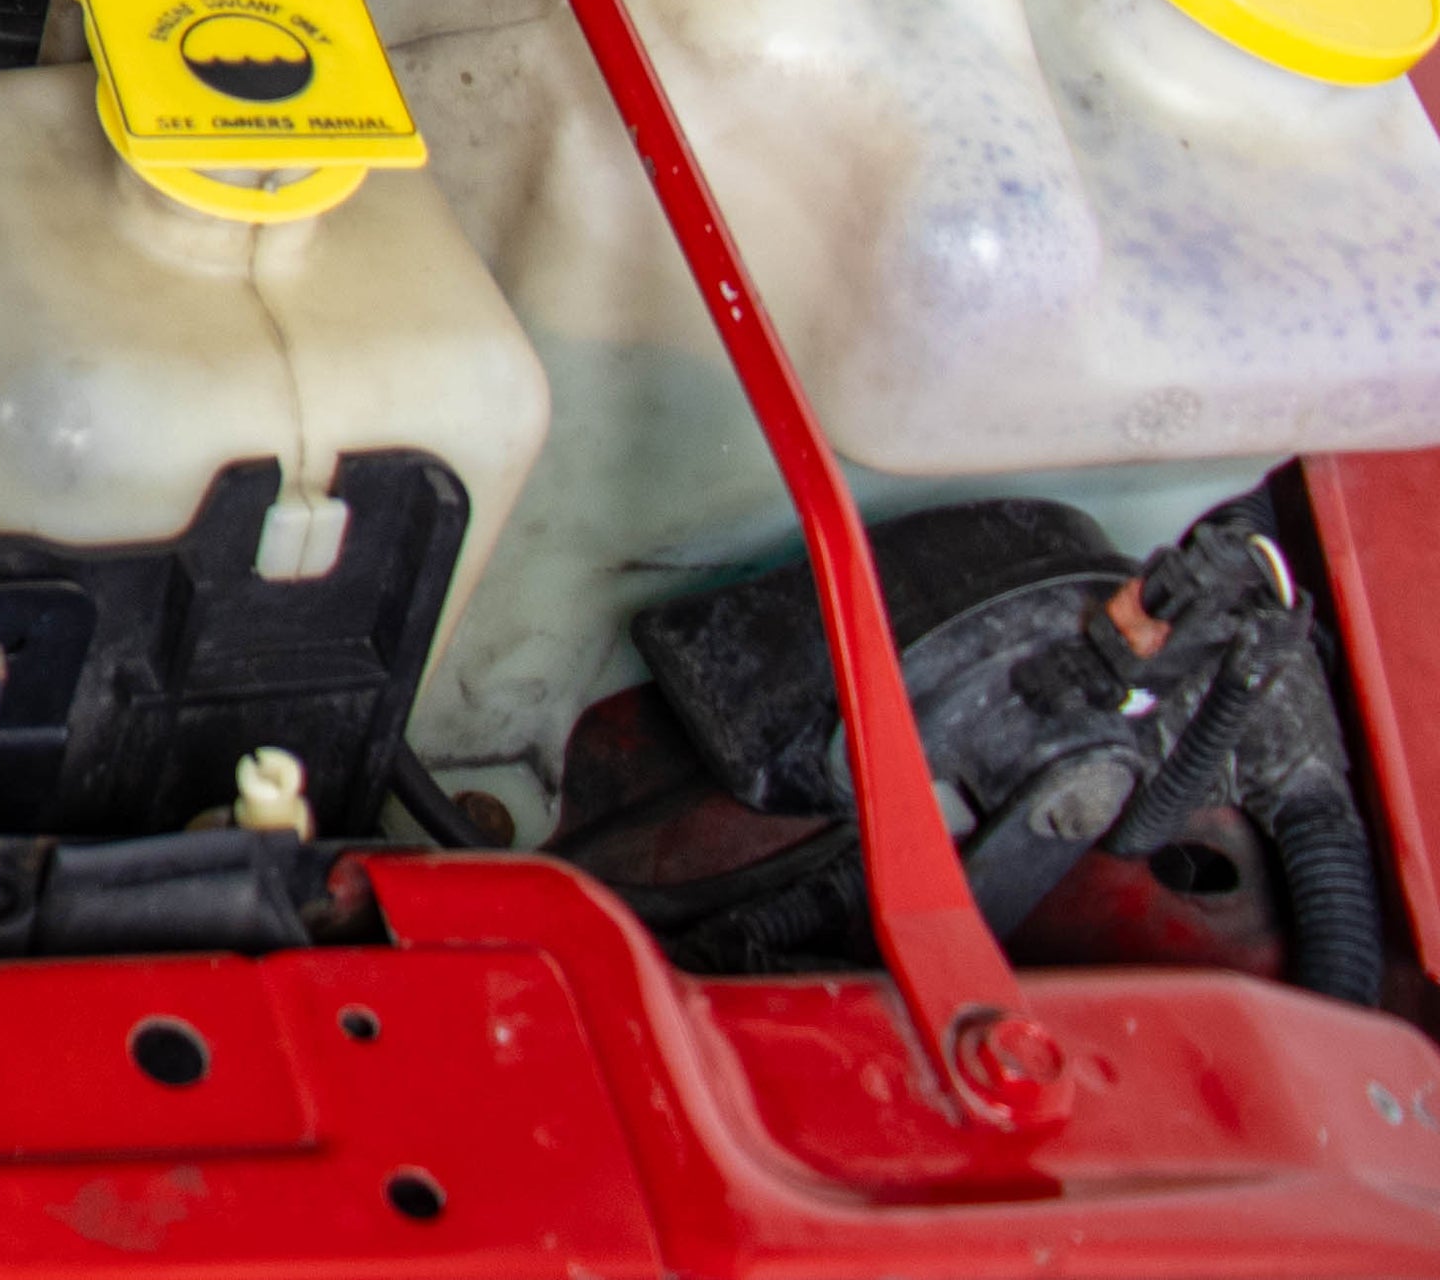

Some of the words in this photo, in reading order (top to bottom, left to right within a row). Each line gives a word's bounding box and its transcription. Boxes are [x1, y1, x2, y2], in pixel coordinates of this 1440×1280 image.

[290, 14, 332, 45] ONLY
[156, 116, 196, 130] SEE
[212, 117, 295, 130] OWNERS
[308, 117, 393, 130] MANUAL
